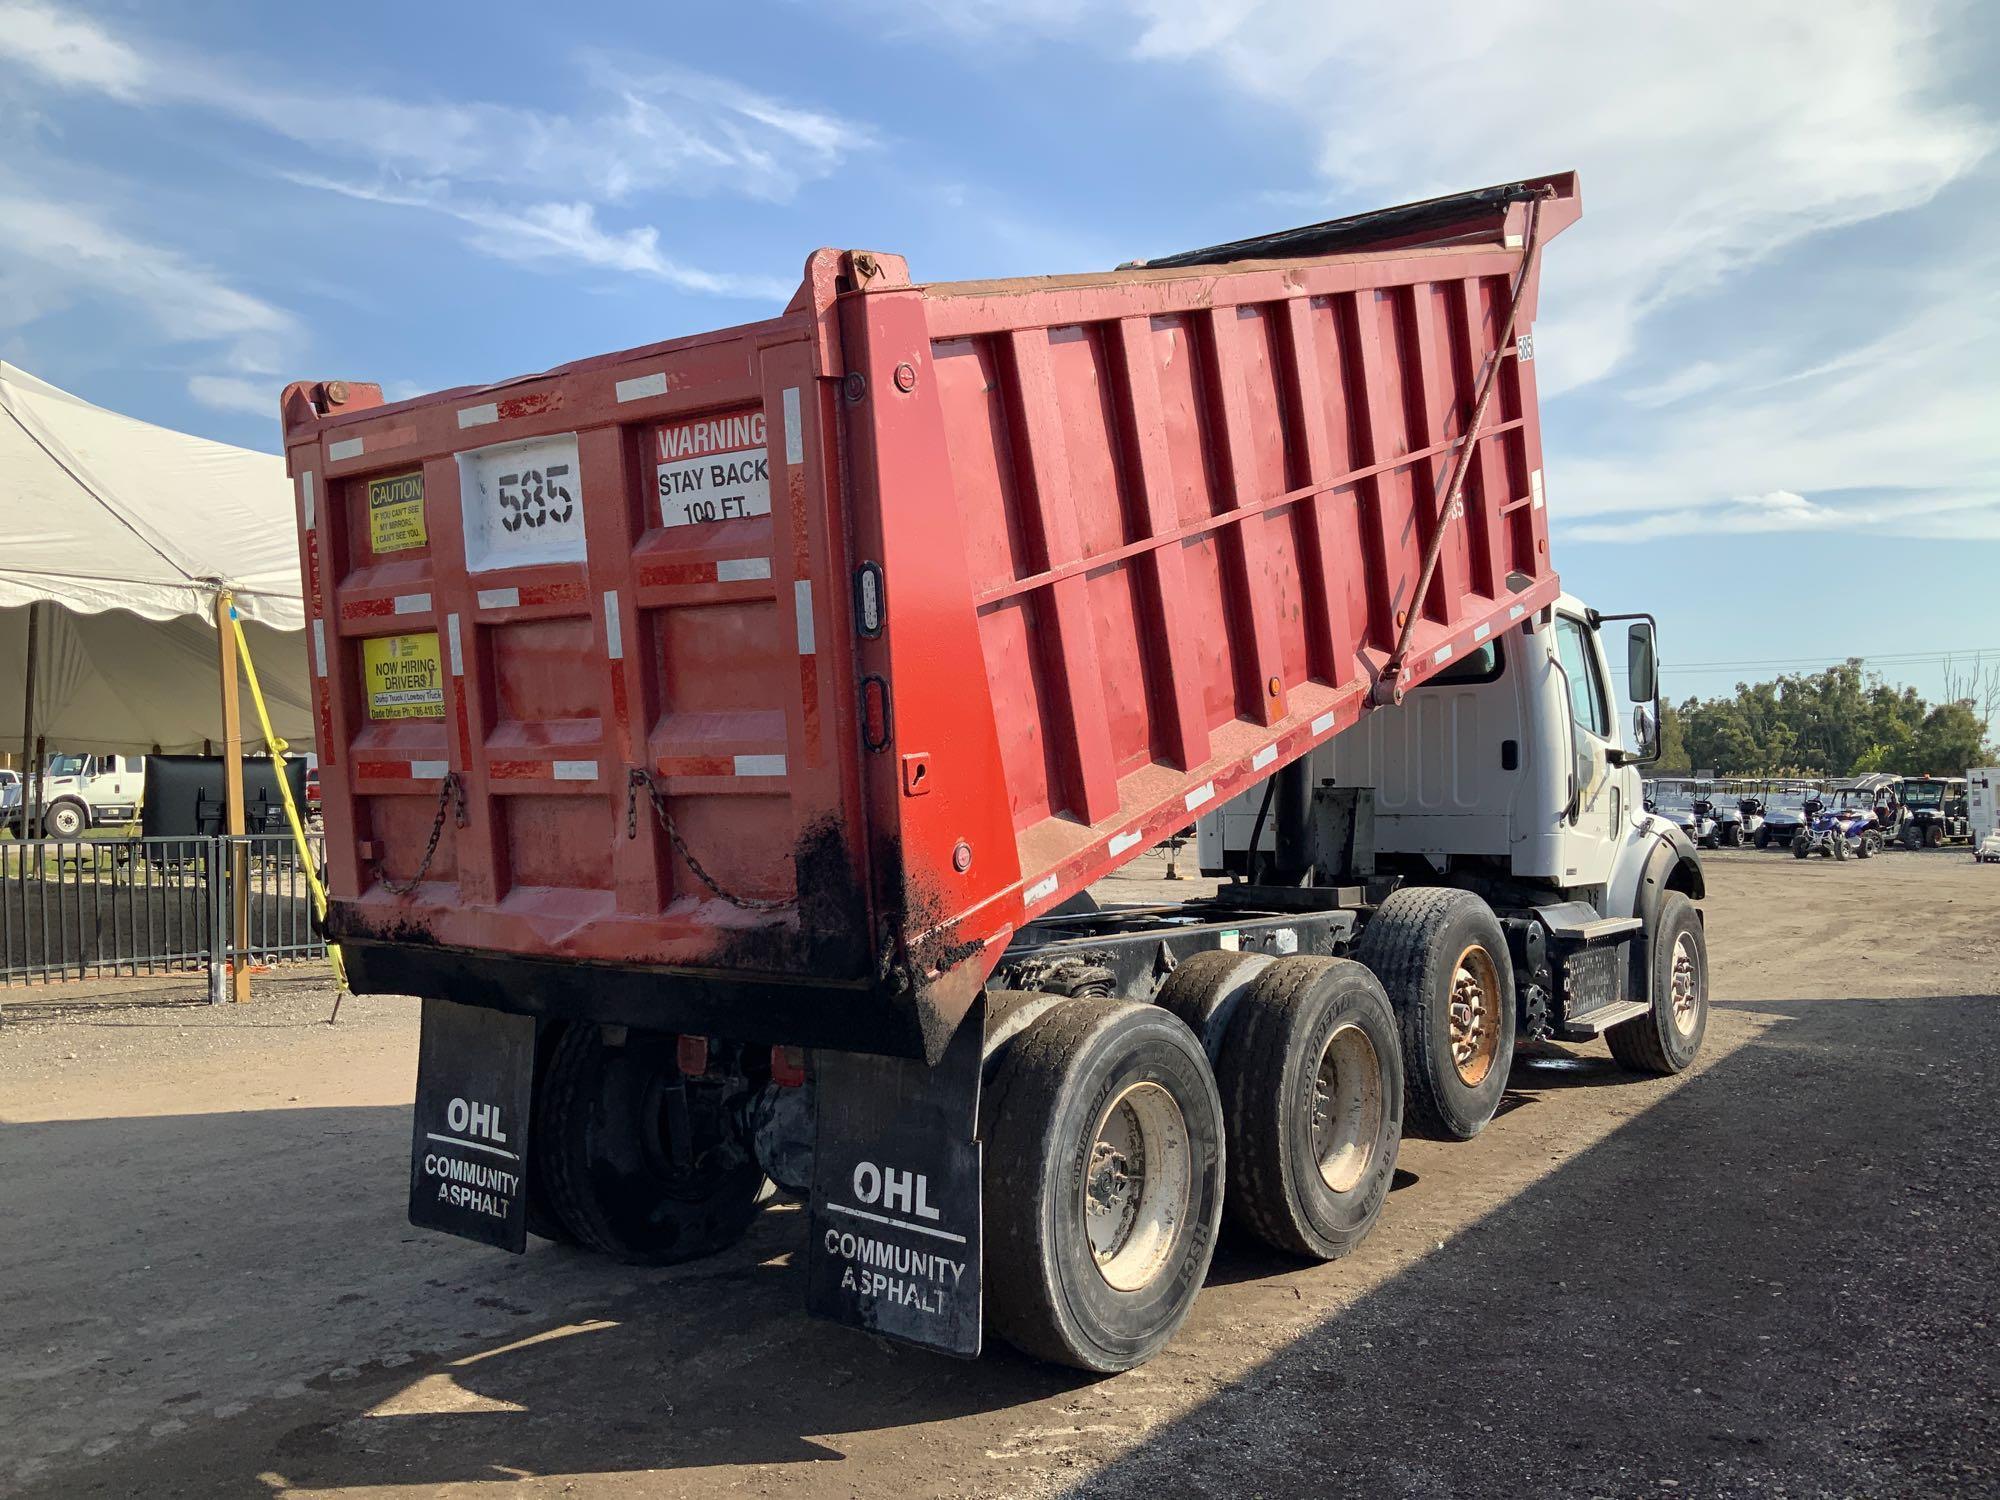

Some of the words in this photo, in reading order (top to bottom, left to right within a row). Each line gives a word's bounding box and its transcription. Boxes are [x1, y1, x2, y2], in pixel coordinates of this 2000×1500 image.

[1519, 336, 1533, 361] 585
[658, 412, 768, 459] WARNING
[372, 479, 420, 505] CAUTION
[659, 467, 704, 495] STAY
[710, 458, 769, 488] BACK
[380, 511, 391, 519] YOU
[392, 508, 407, 517] CAN'T
[499, 464, 573, 532] 585
[684, 500, 716, 524] 100
[721, 495, 750, 519] FT.
[380, 523, 388, 531] MY
[380, 534, 395, 542] CAN'T
[395, 531, 406, 539] SEE
[375, 661, 398, 676] NOW
[401, 658, 436, 673] HIRING
[407, 691, 425, 702] Lowboy
[426, 690, 441, 700] Truck
[448, 1097, 507, 1143] OHL
[425, 1153, 519, 1197] COMMUNITY
[853, 1161, 940, 1220] OHL
[438, 1182, 510, 1219] ASPHALT
[825, 1229, 966, 1288] COMMUNITY
[841, 1266, 948, 1315] ASPHALT
